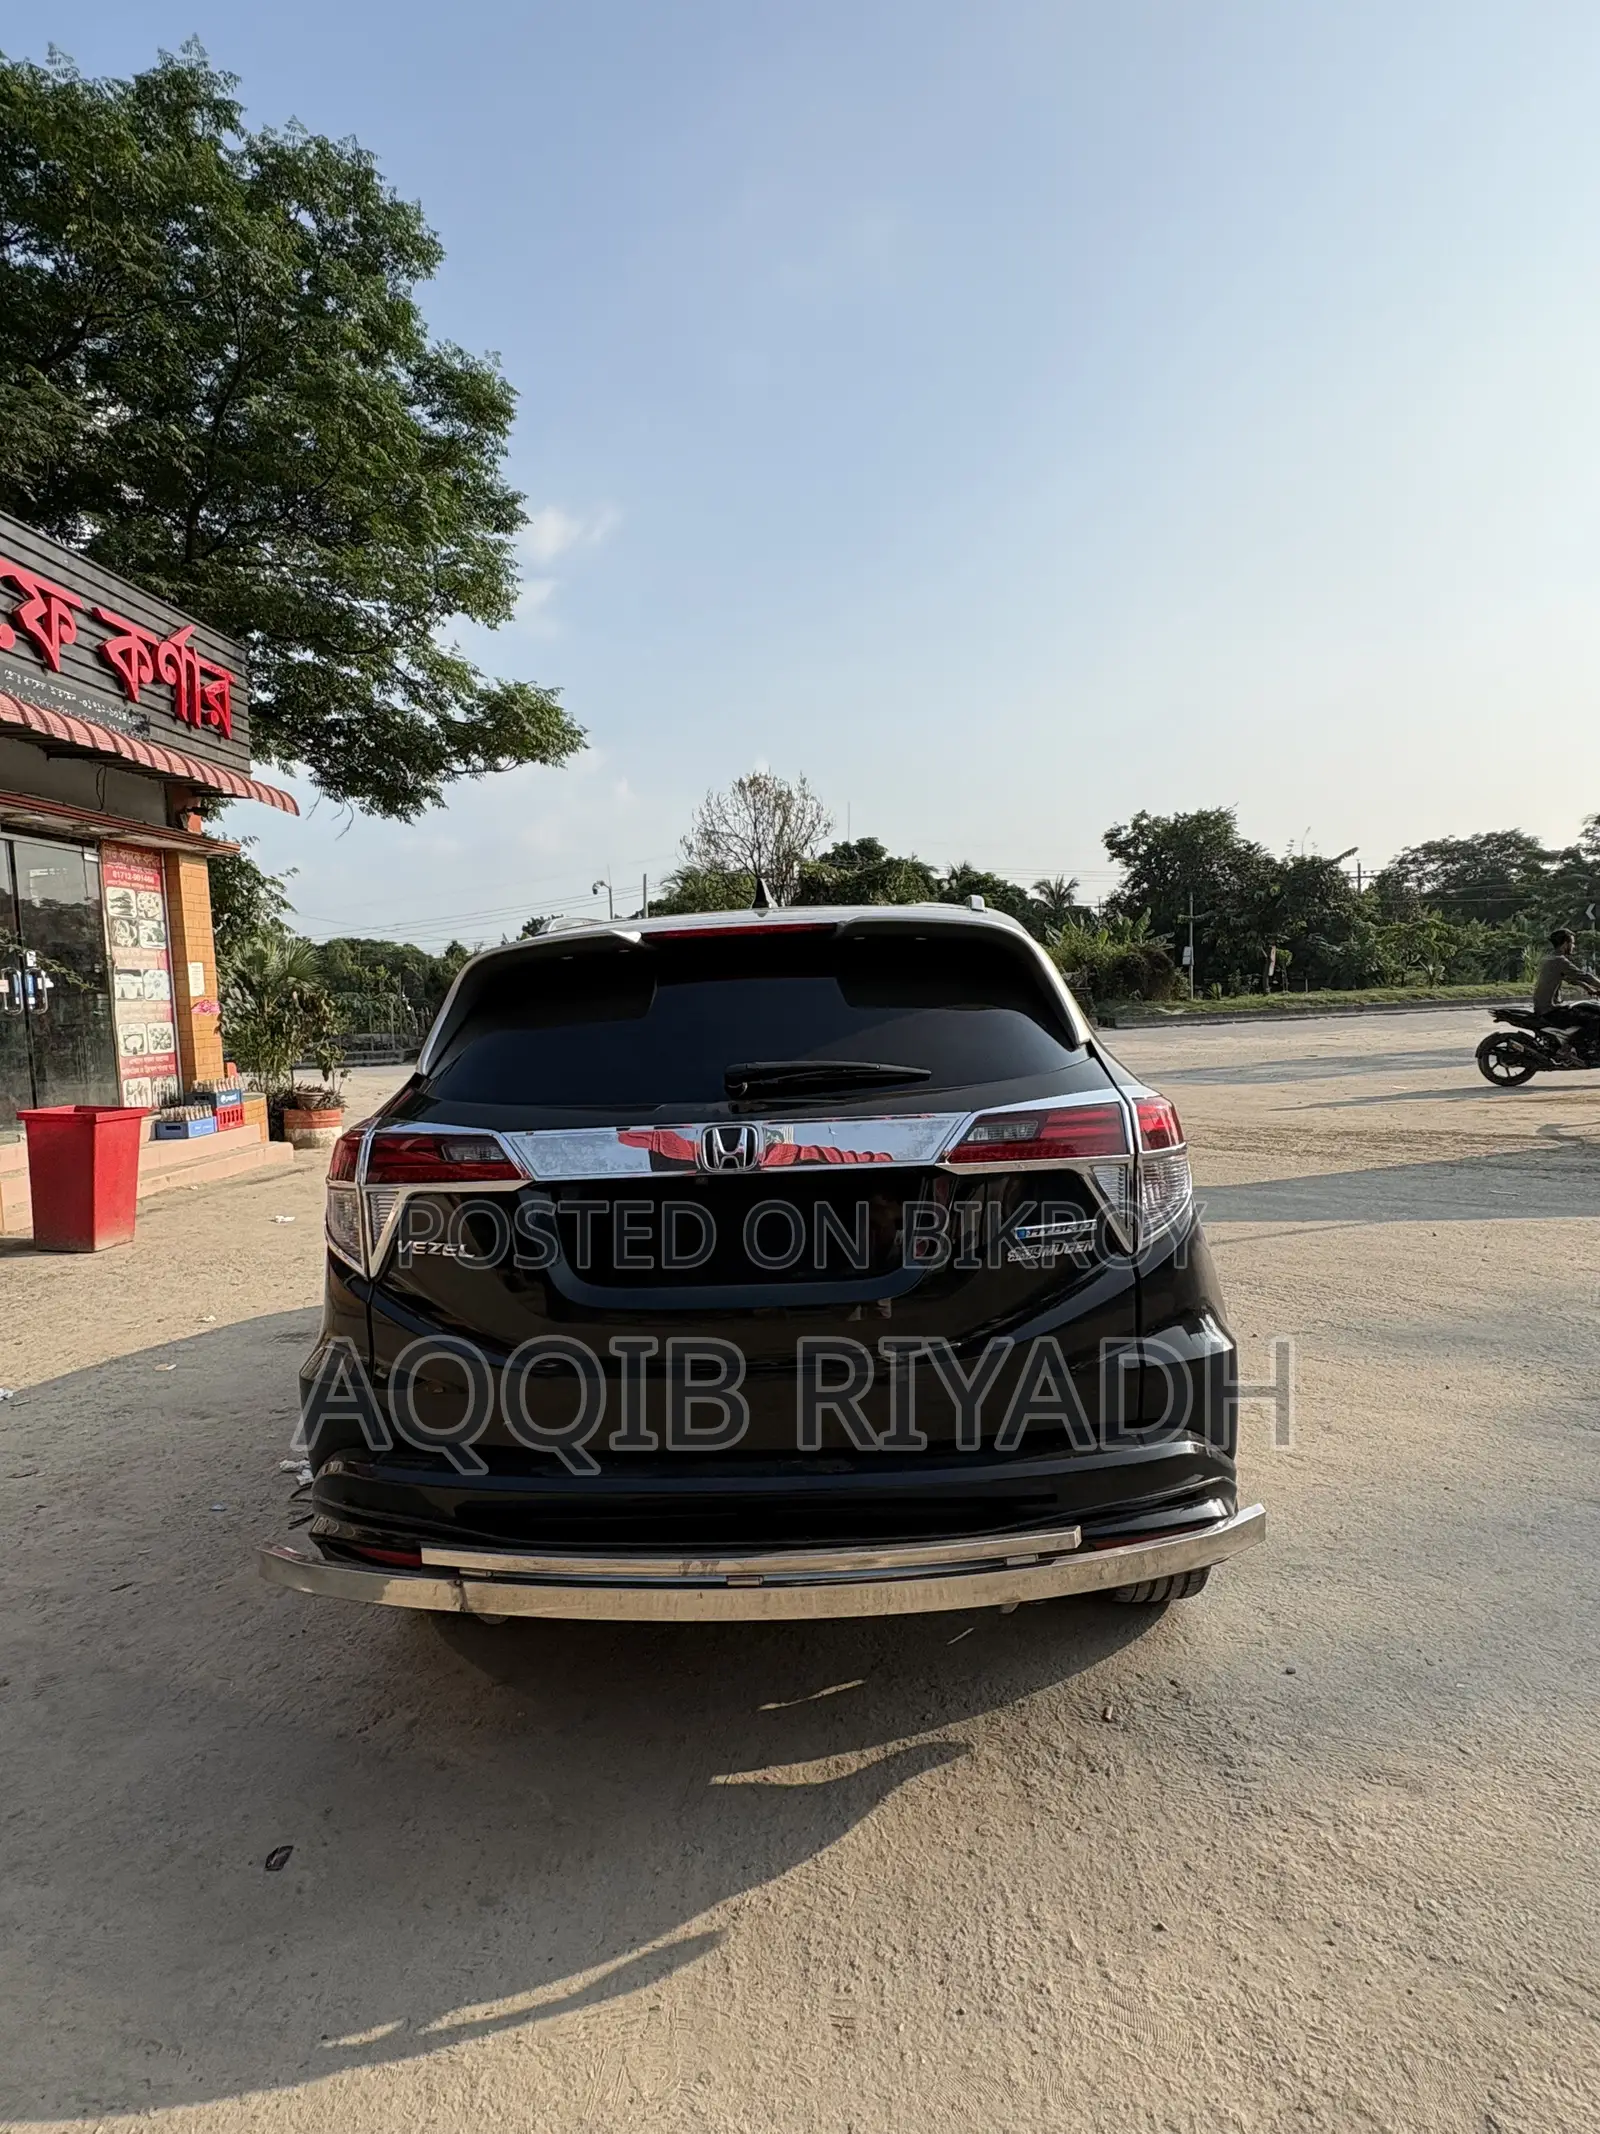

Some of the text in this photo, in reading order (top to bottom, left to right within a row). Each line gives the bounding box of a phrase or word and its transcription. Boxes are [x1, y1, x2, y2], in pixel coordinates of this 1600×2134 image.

[91, 607, 235, 740] কর্ণার
[1029, 1222, 1095, 1236] HYBRID
[397, 1240, 475, 1258] VEZEL
[1042, 1240, 1095, 1257] MUGEN
